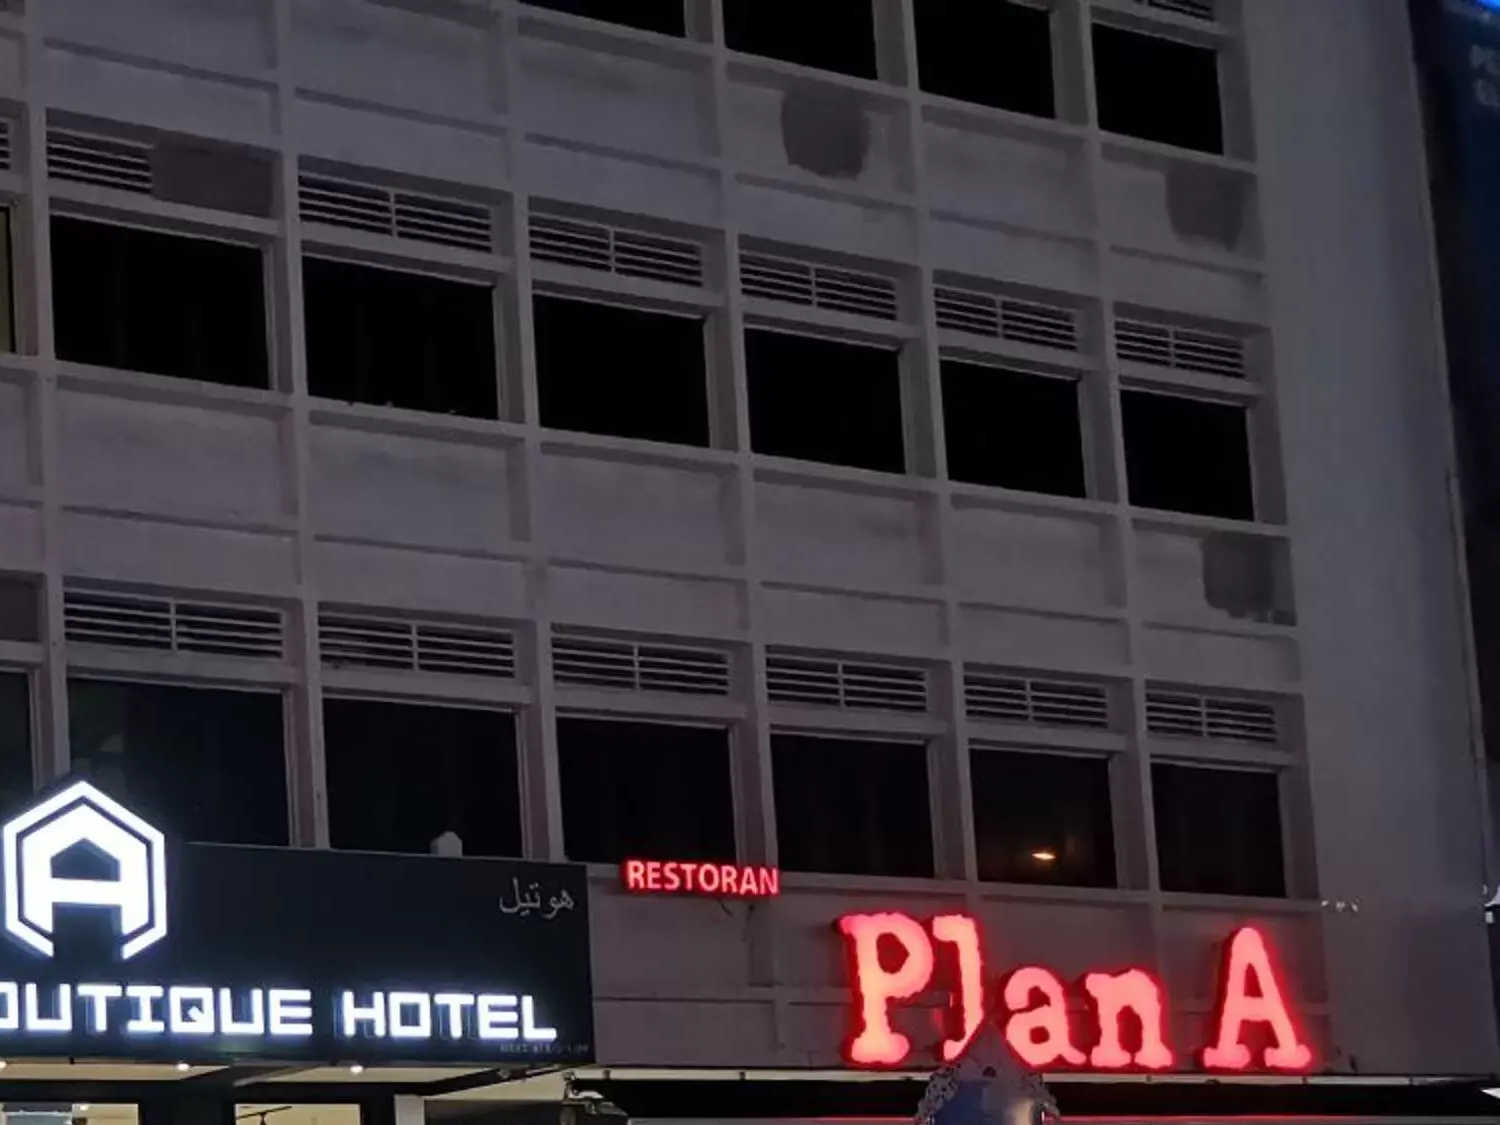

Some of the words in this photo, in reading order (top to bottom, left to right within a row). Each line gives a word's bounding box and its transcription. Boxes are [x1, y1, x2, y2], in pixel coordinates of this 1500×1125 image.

[500, 877, 575, 920] هوتيل
[626, 861, 780, 896] RESTORAN
[840, 912, 1175, 1070] Plan
[1203, 927, 1314, 1070] A
[342, 991, 557, 1041] HOTEL
